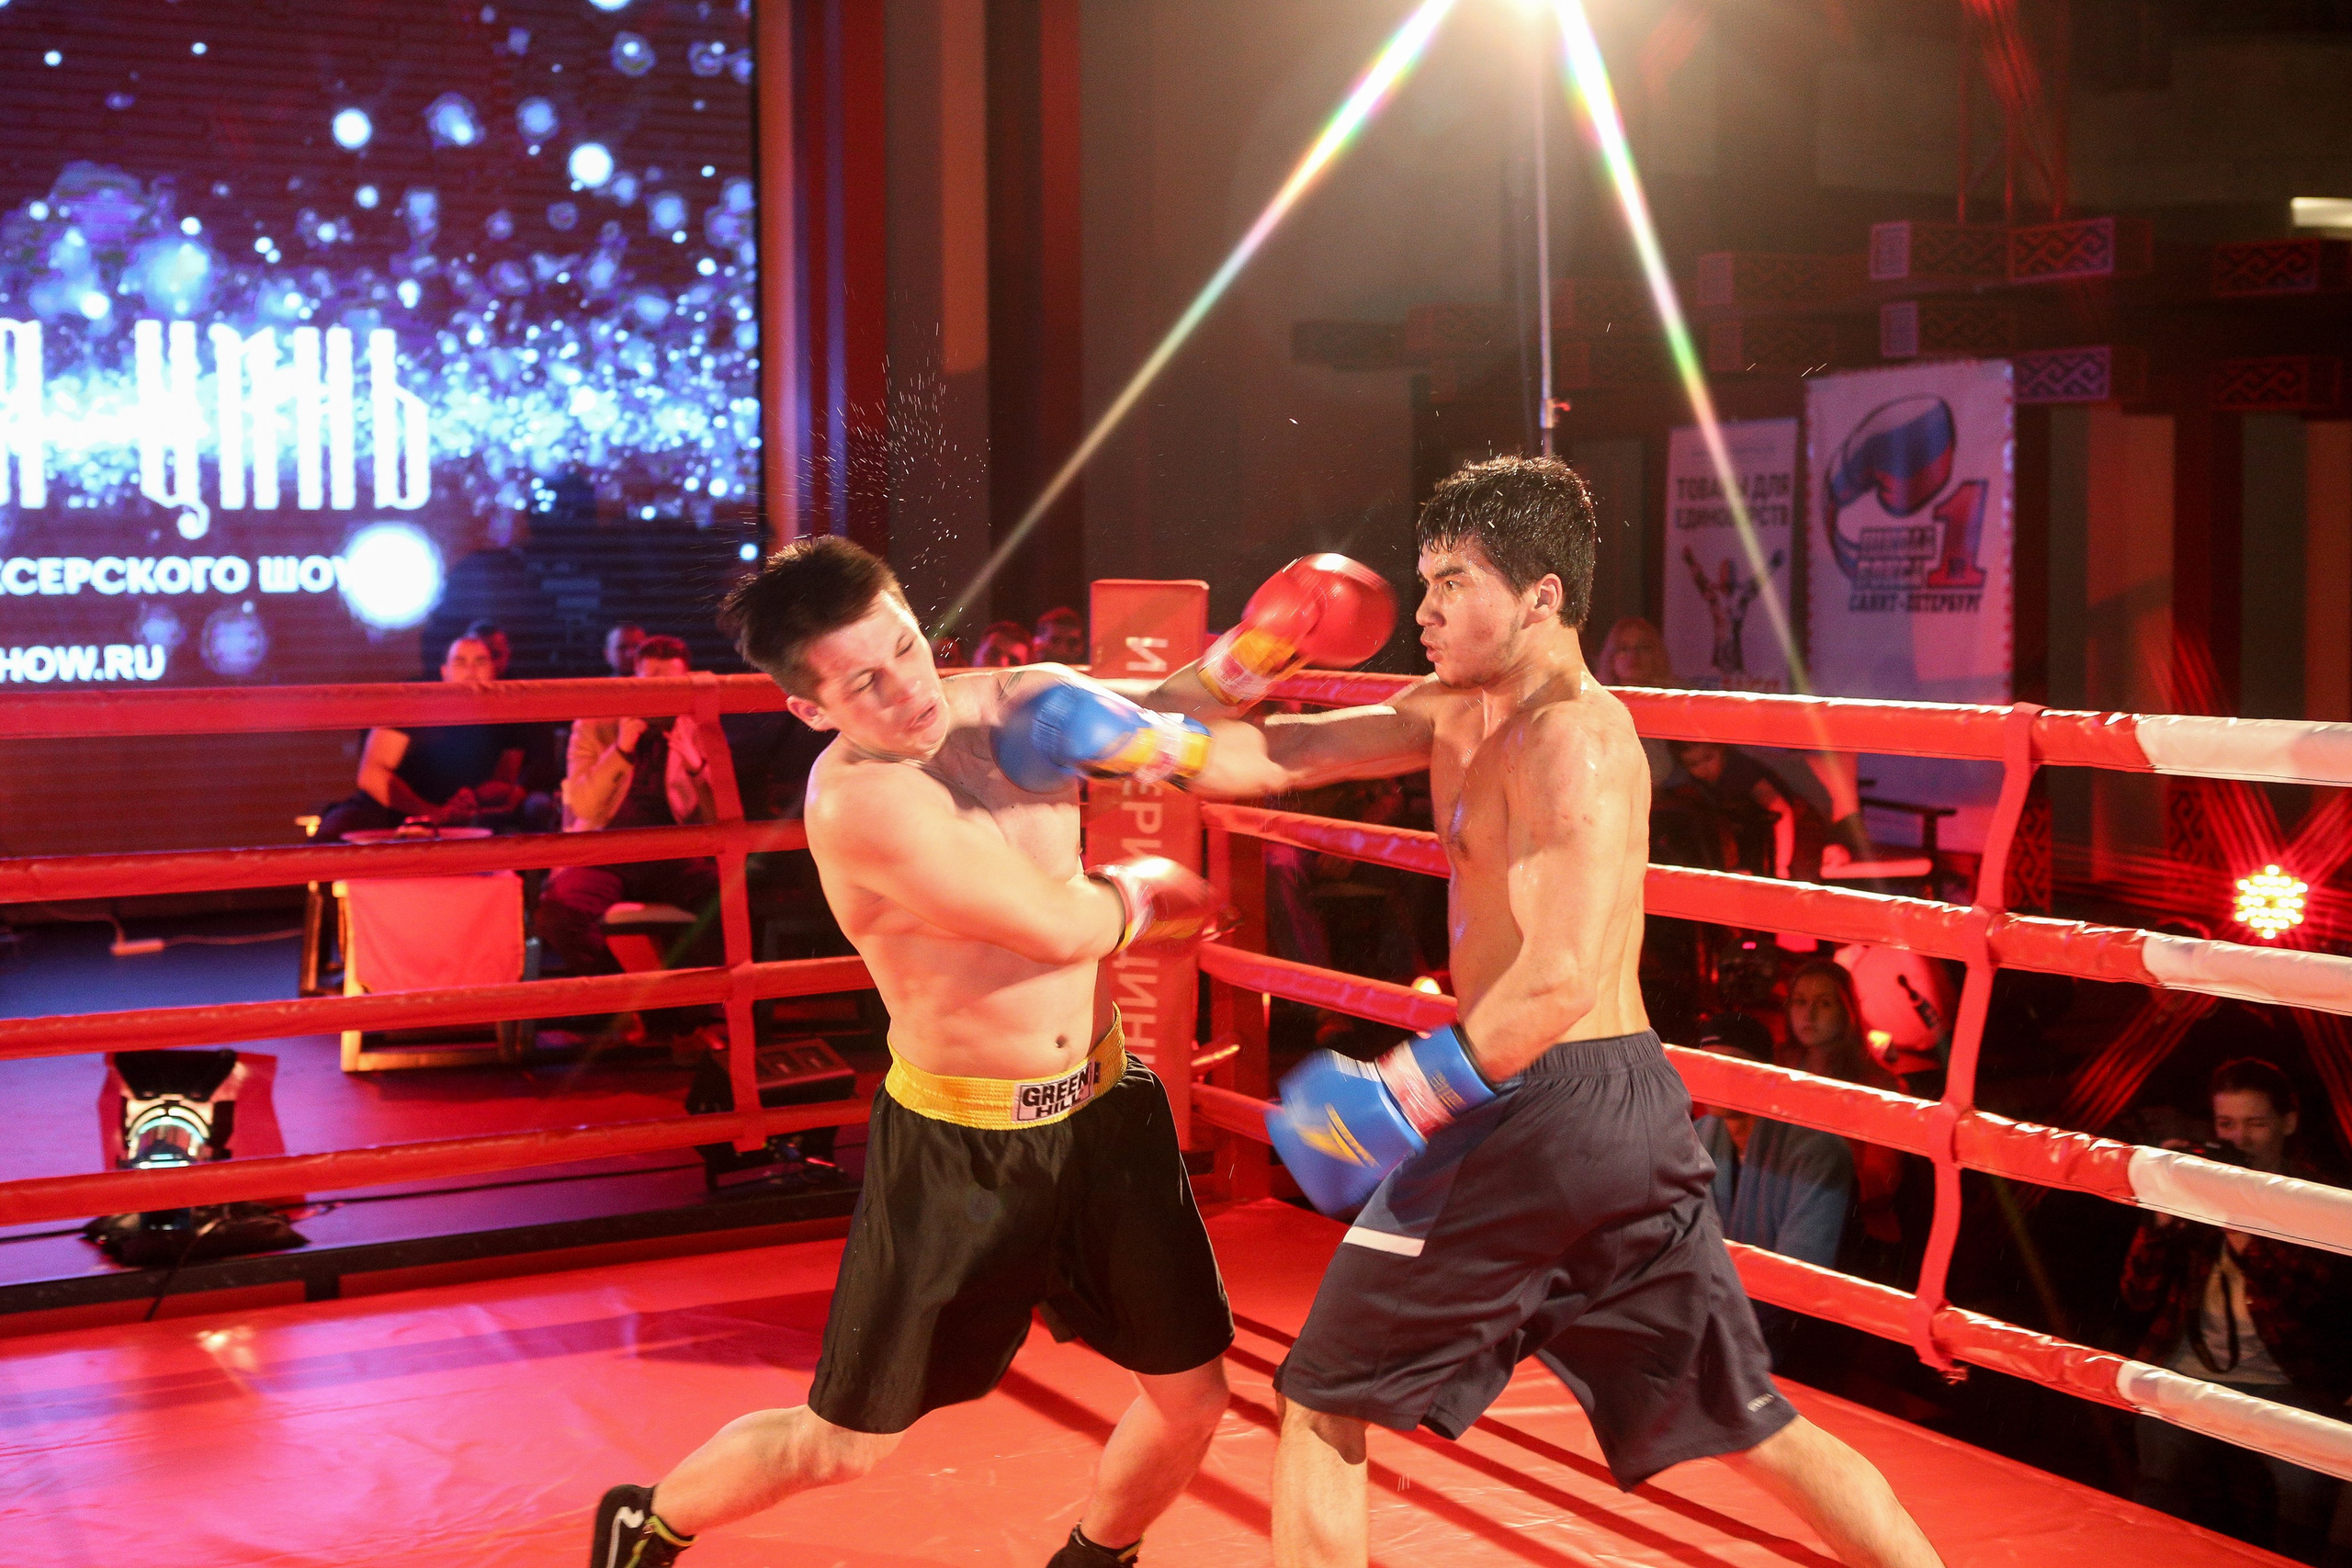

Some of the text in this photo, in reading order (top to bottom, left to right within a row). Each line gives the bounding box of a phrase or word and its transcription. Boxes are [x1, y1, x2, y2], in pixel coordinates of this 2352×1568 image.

[1676, 475, 1748, 500] ТОВАЫ
[1675, 504, 1790, 529] ЕДИНОРСТВ
[0, 555, 250, 596] СЕРСКОГО
[1022, 1065, 1090, 1107] GREEN
[1035, 1093, 1082, 1118] HILL
